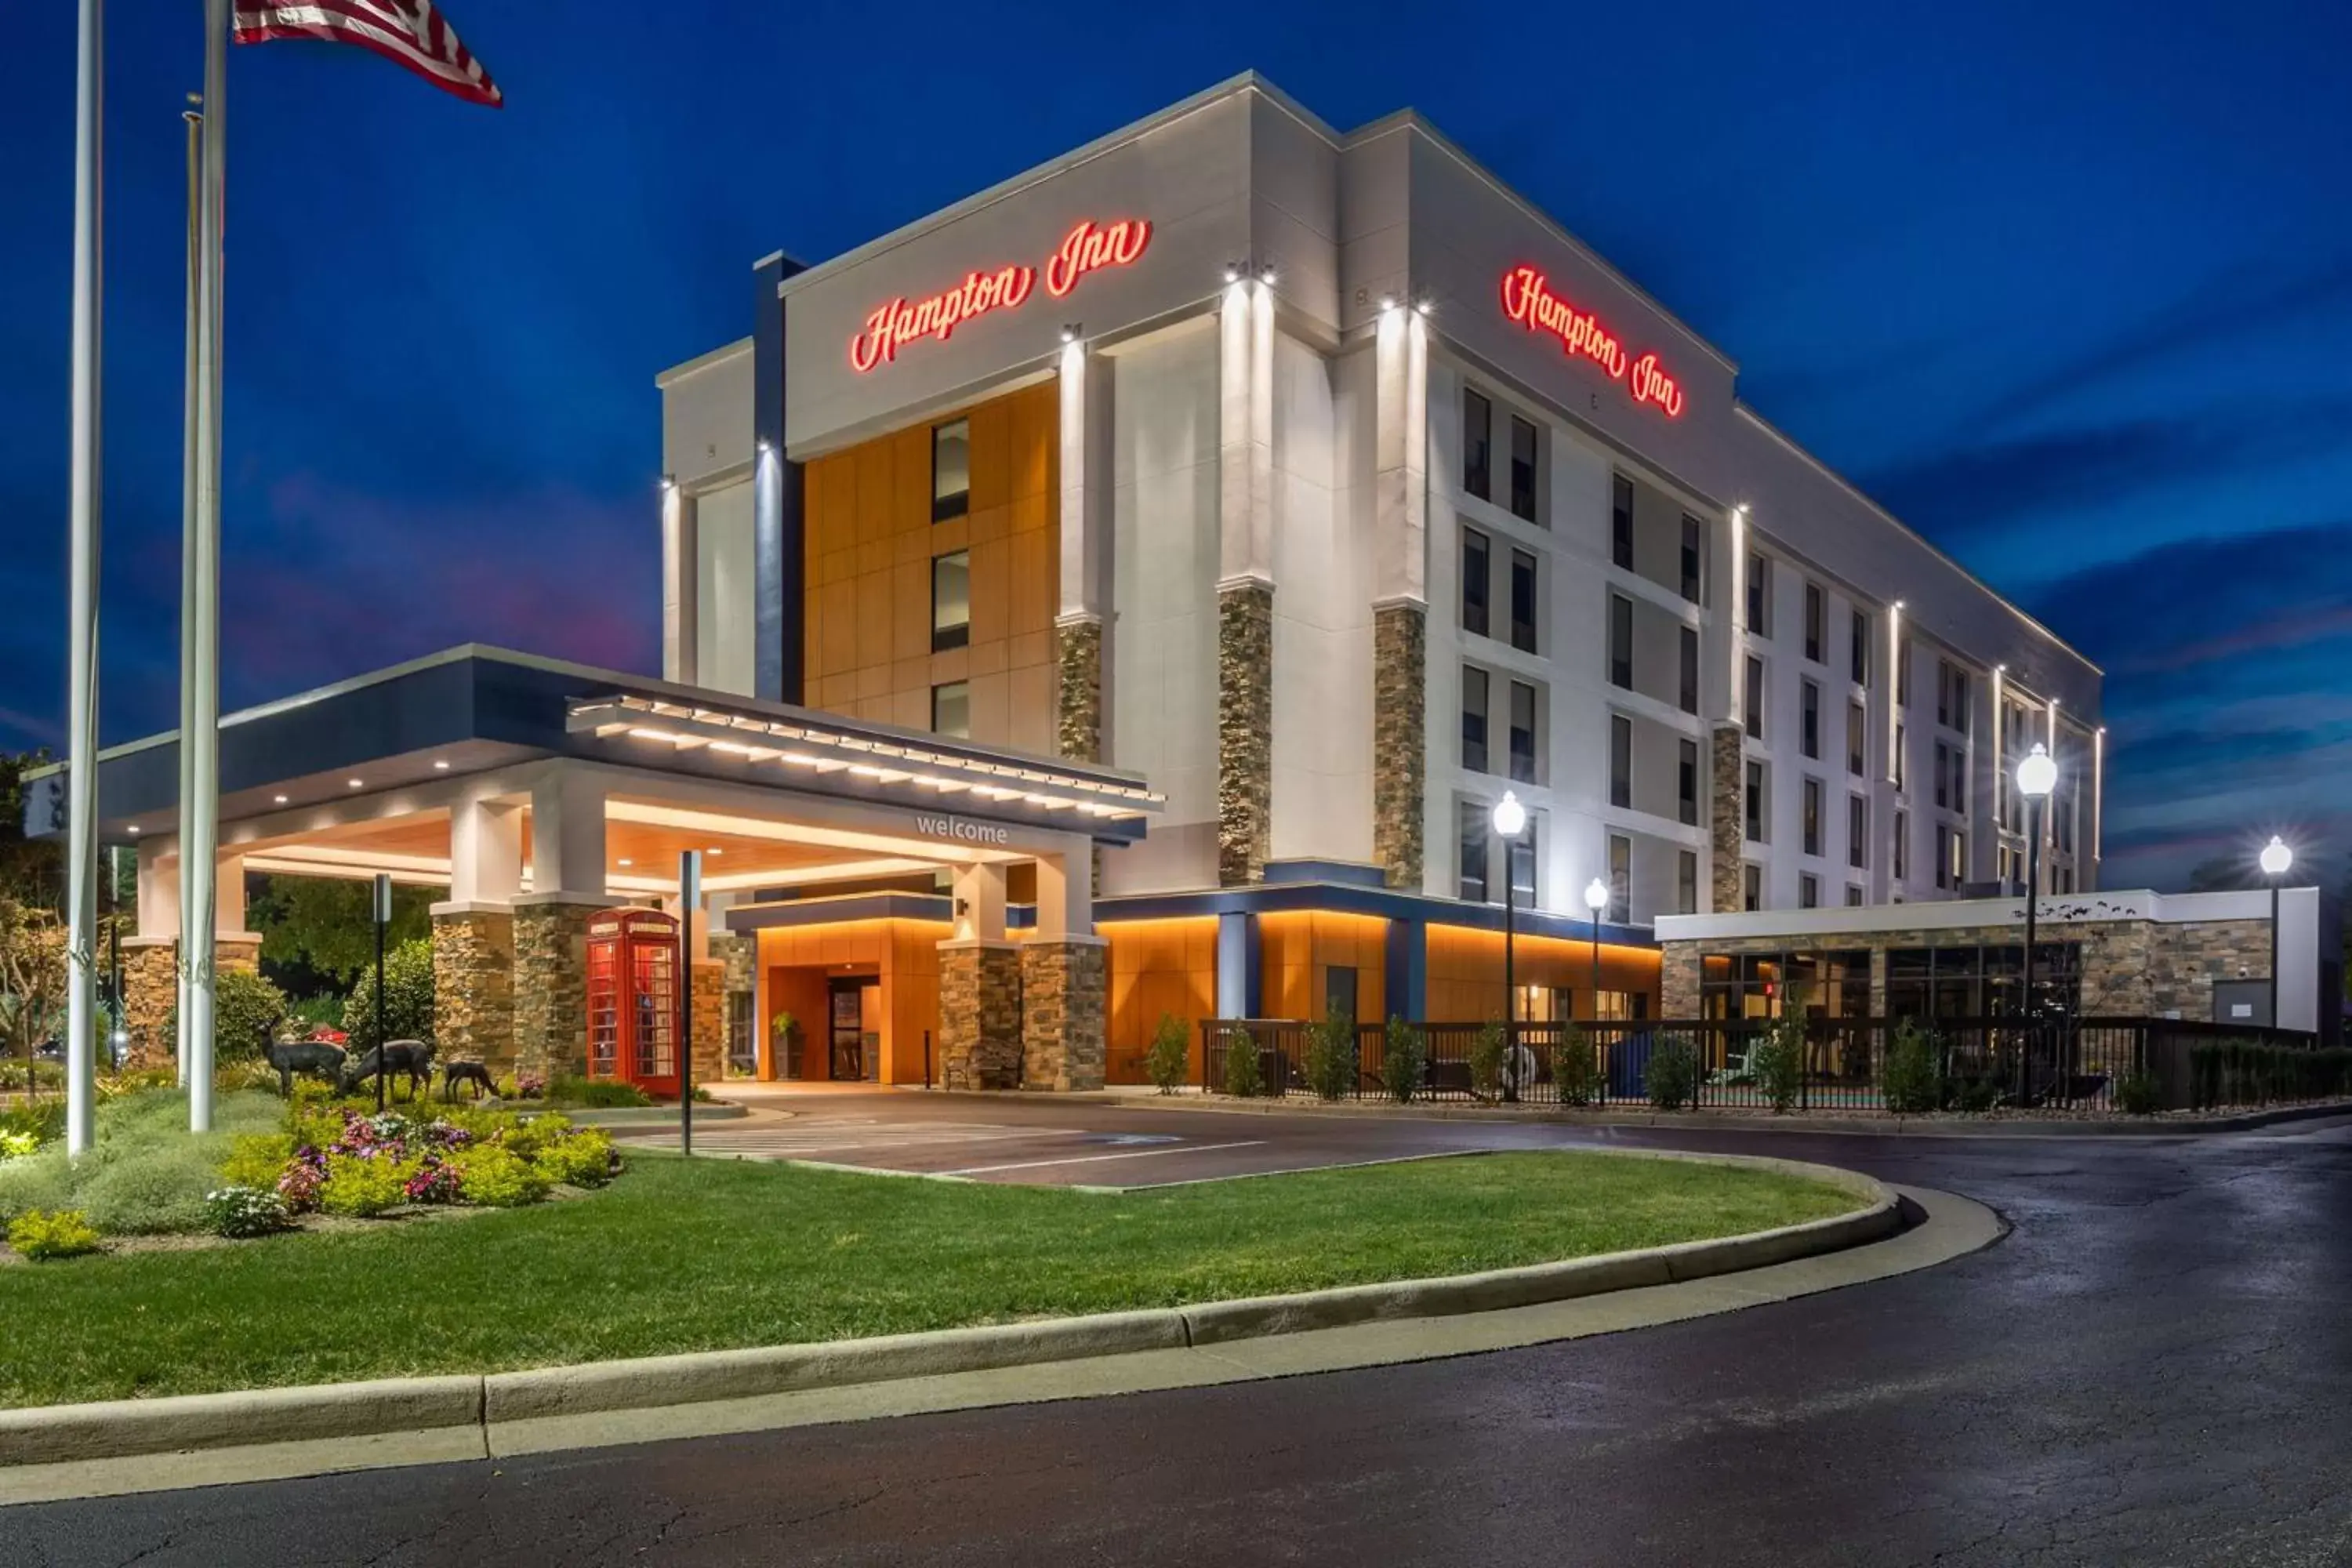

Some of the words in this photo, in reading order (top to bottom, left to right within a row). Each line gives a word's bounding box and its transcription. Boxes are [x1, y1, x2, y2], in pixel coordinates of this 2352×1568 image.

[852, 266, 1036, 371] Hampton
[1047, 220, 1152, 296] Inn
[1502, 267, 1626, 378] Hampton
[1631, 354, 1682, 416] Inn
[916, 815, 1007, 844] welcome
